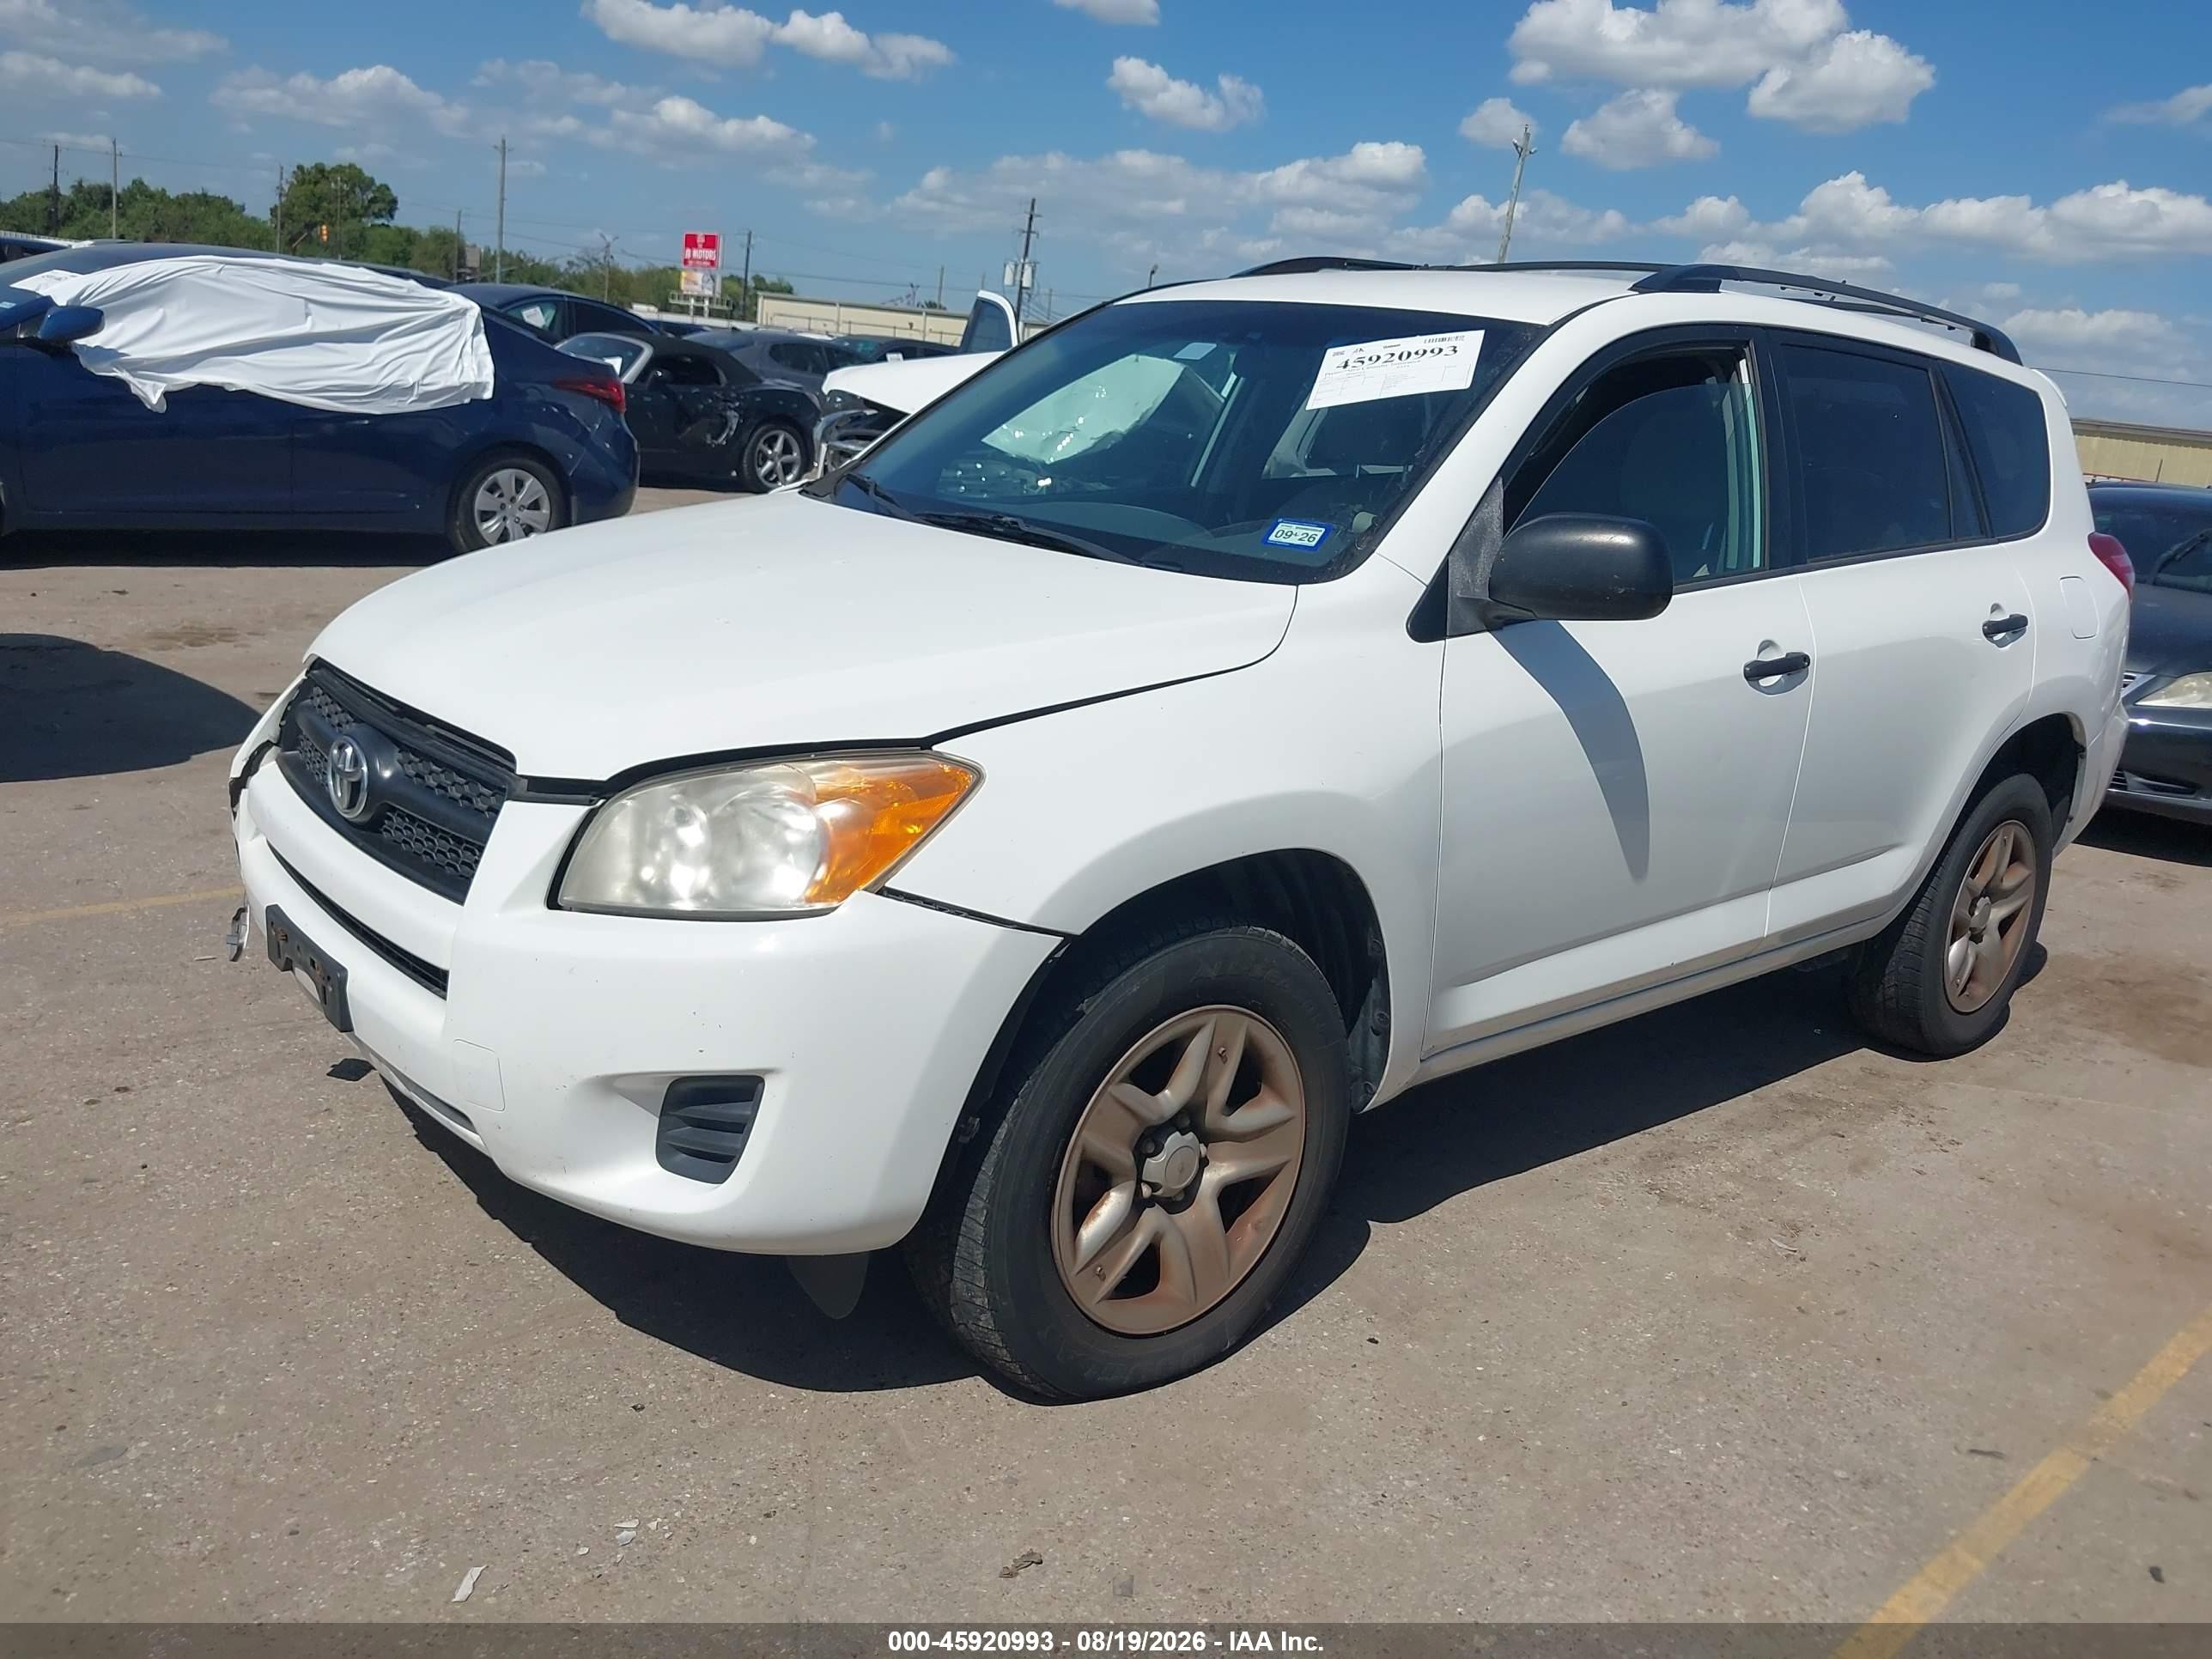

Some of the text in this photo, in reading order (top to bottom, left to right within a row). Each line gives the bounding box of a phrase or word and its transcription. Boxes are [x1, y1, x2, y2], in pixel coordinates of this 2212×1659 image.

[1335, 345, 1459, 370] 45920993
[1274, 529, 1318, 543] 09 26
